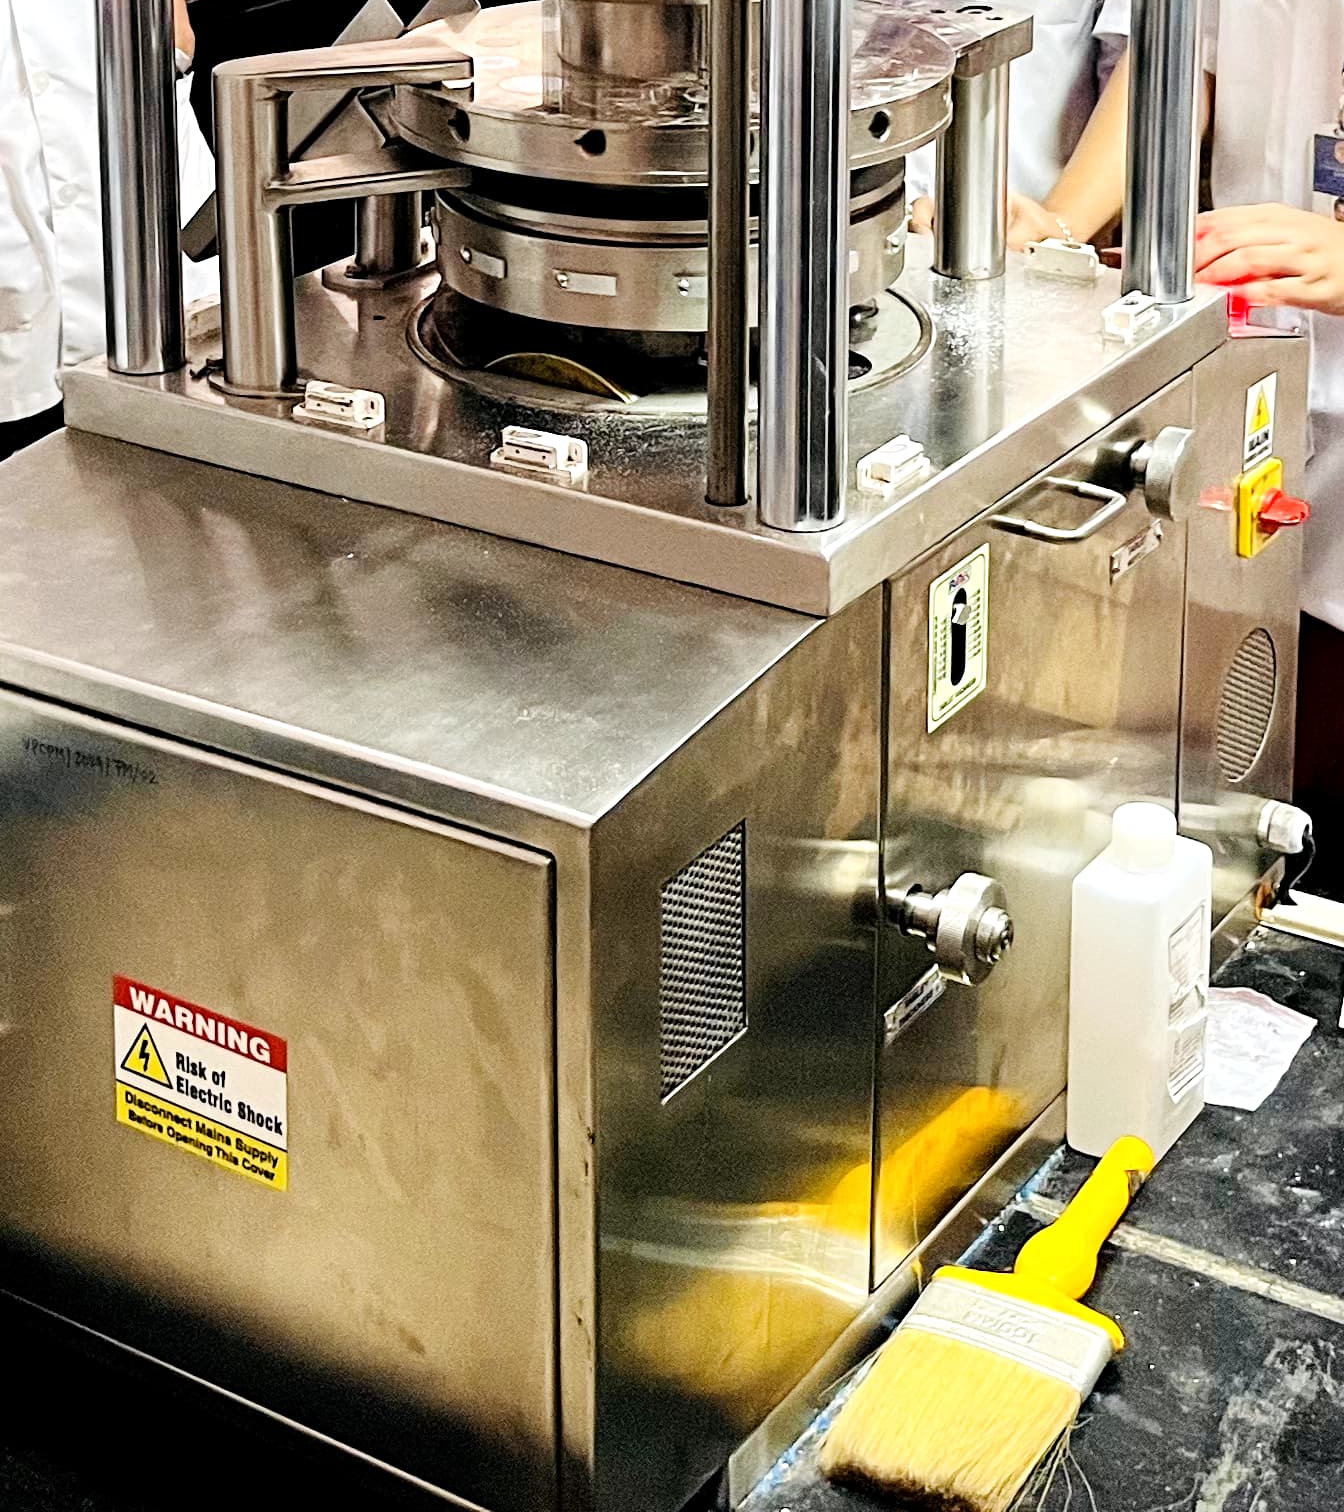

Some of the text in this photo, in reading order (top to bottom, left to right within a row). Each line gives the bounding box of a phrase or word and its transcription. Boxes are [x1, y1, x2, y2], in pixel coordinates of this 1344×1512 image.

[129, 986, 272, 1064] WARNING
[175, 1051, 227, 1088] Risk of
[176, 1075, 283, 1136] Electric Shock
[125, 1090, 279, 1169] Disconnect Mains Supply
[128, 1109, 276, 1181] Before Opening This Cover
